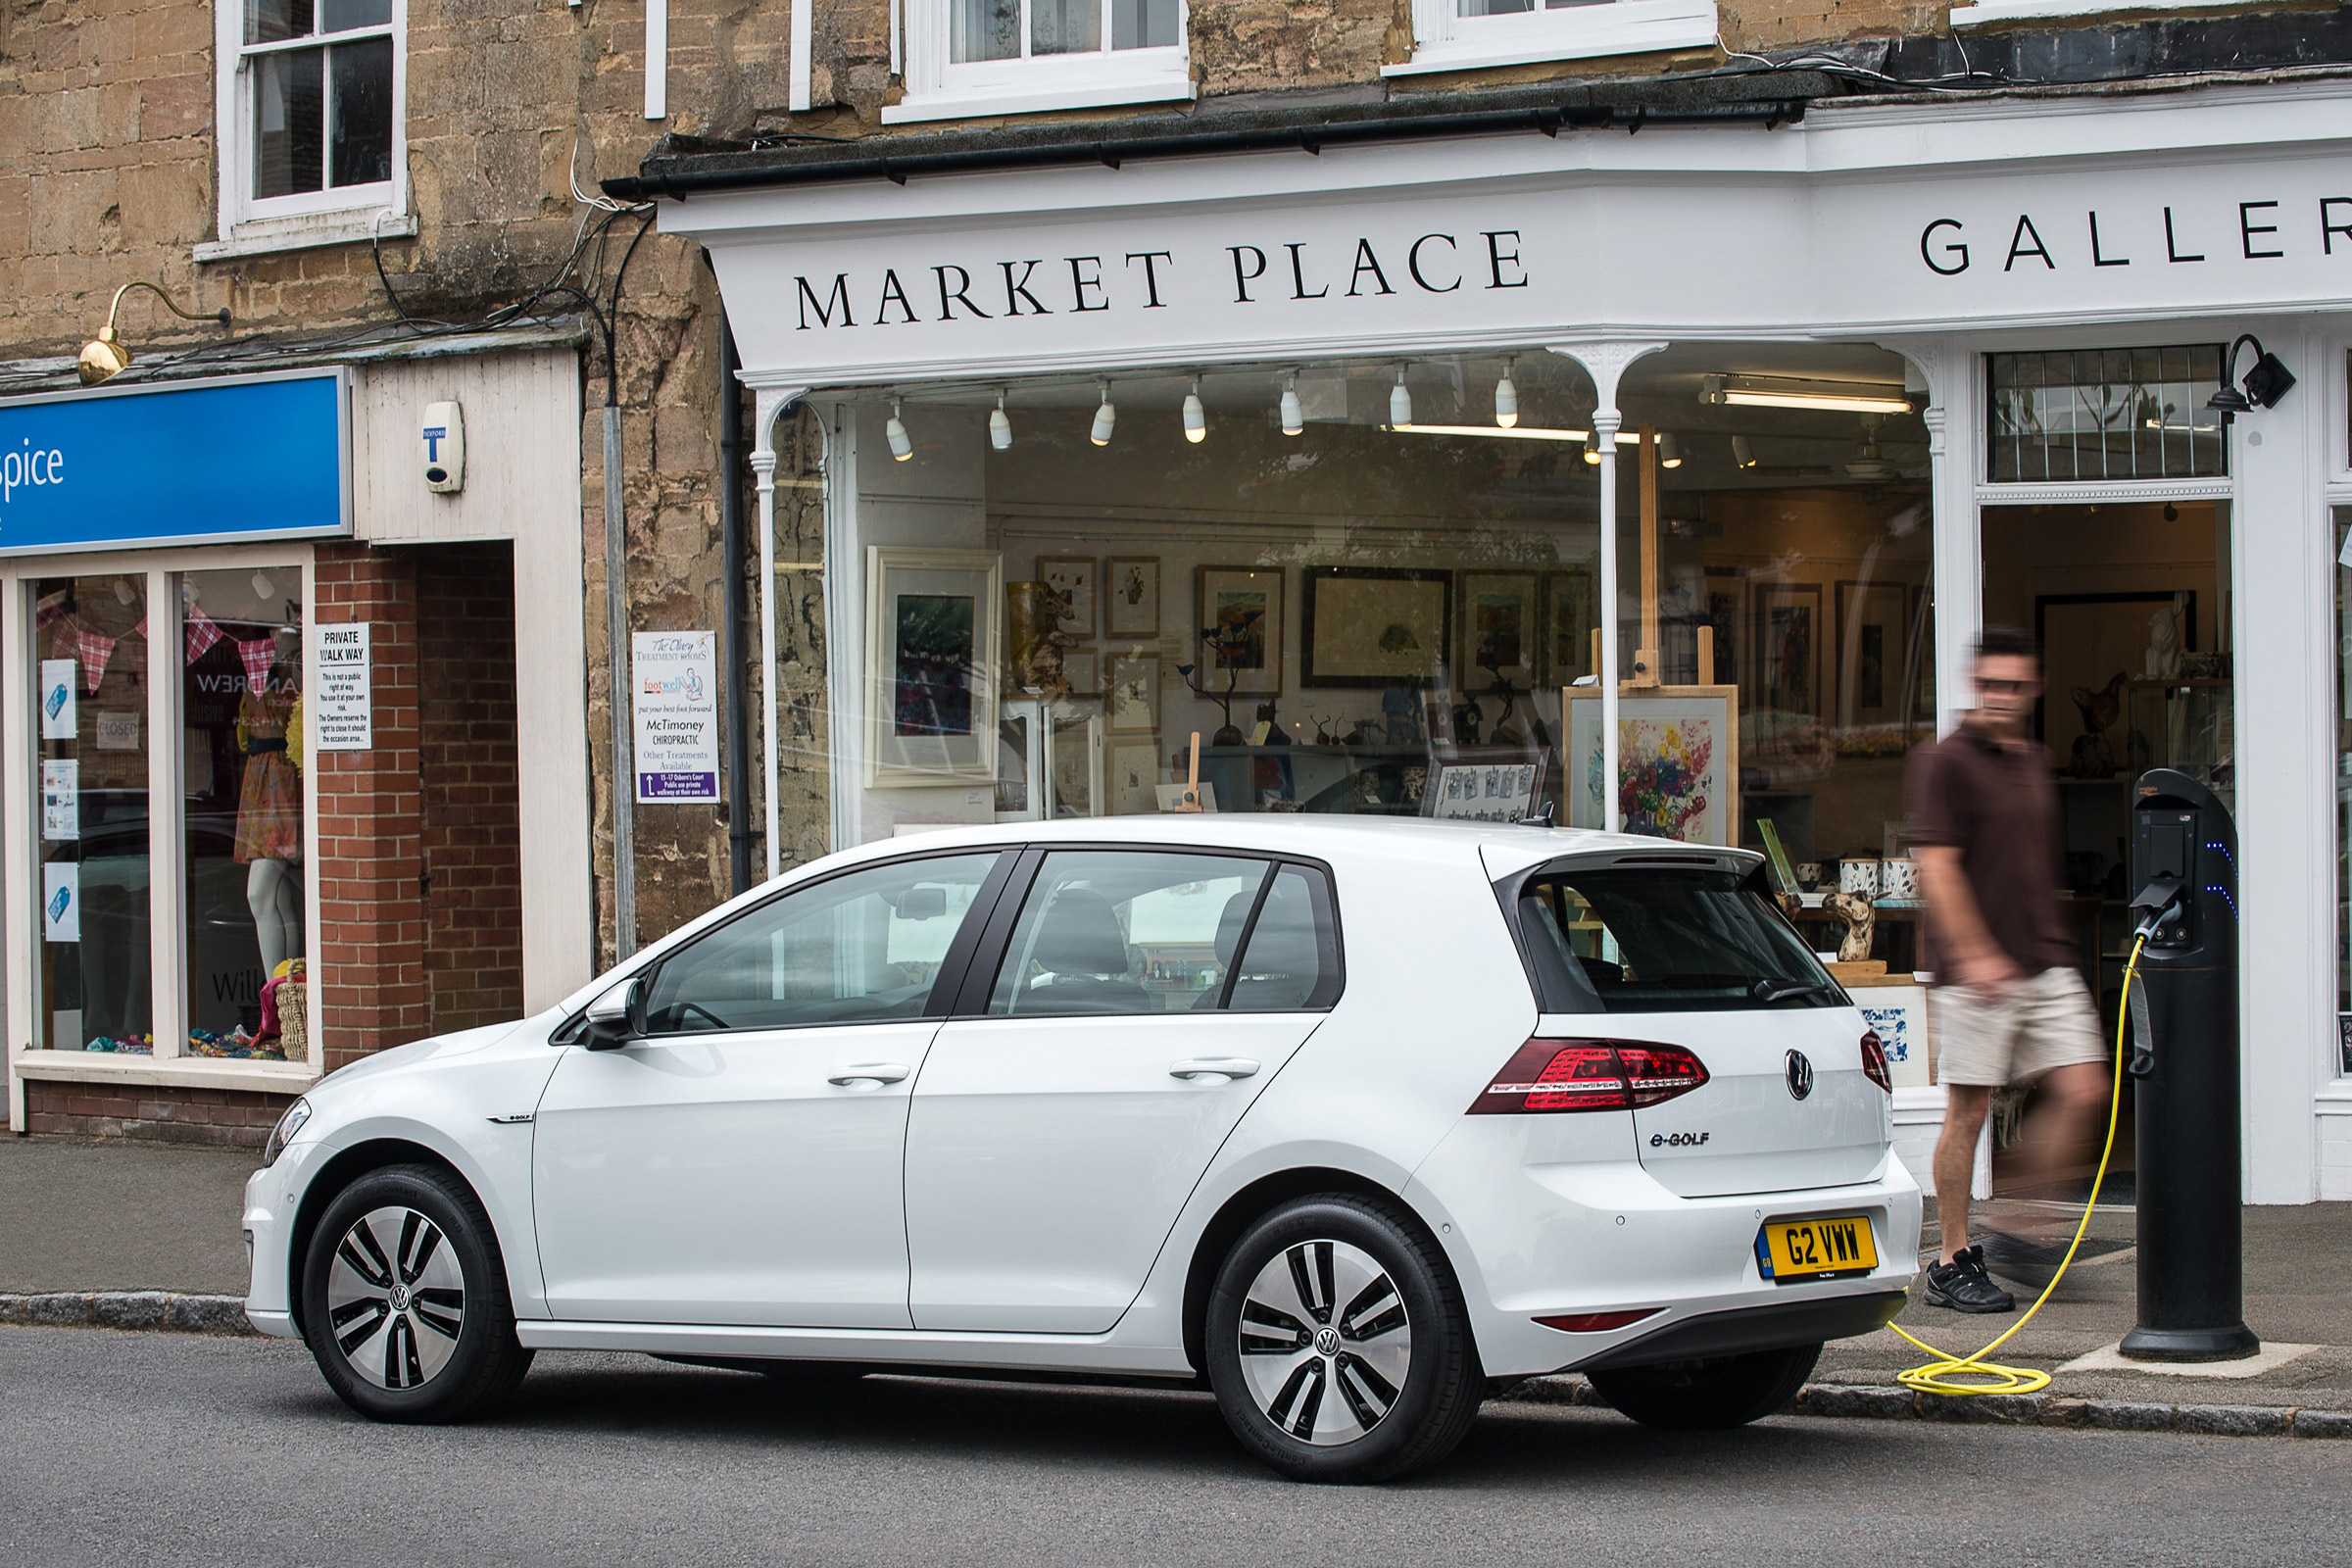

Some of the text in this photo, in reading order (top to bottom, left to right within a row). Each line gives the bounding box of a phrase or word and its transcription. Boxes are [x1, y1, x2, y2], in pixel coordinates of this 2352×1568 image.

[1919, 196, 2352, 276] GALLER
[792, 229, 1530, 331] MARKET PLACE
[0, 437, 64, 504] pice
[324, 631, 359, 644] PRIVATE
[319, 648, 364, 662] WALK WAY
[636, 652, 678, 662] TREATMENT
[348, 672, 362, 682] public
[329, 684, 339, 693] right
[345, 695, 355, 704] your
[638, 704, 712, 714] put your best foot forward
[98, 722, 137, 736] CLOSED
[319, 725, 330, 734] right
[646, 718, 705, 733] McTimoney
[653, 734, 700, 746] CHIROPRACTIC
[643, 751, 709, 760] Other Treatments
[660, 761, 693, 771] Available
[213, 968, 267, 1003] Will
[1786, 1223, 1860, 1265] G2 VWW
[1762, 1257, 1772, 1267] GB
